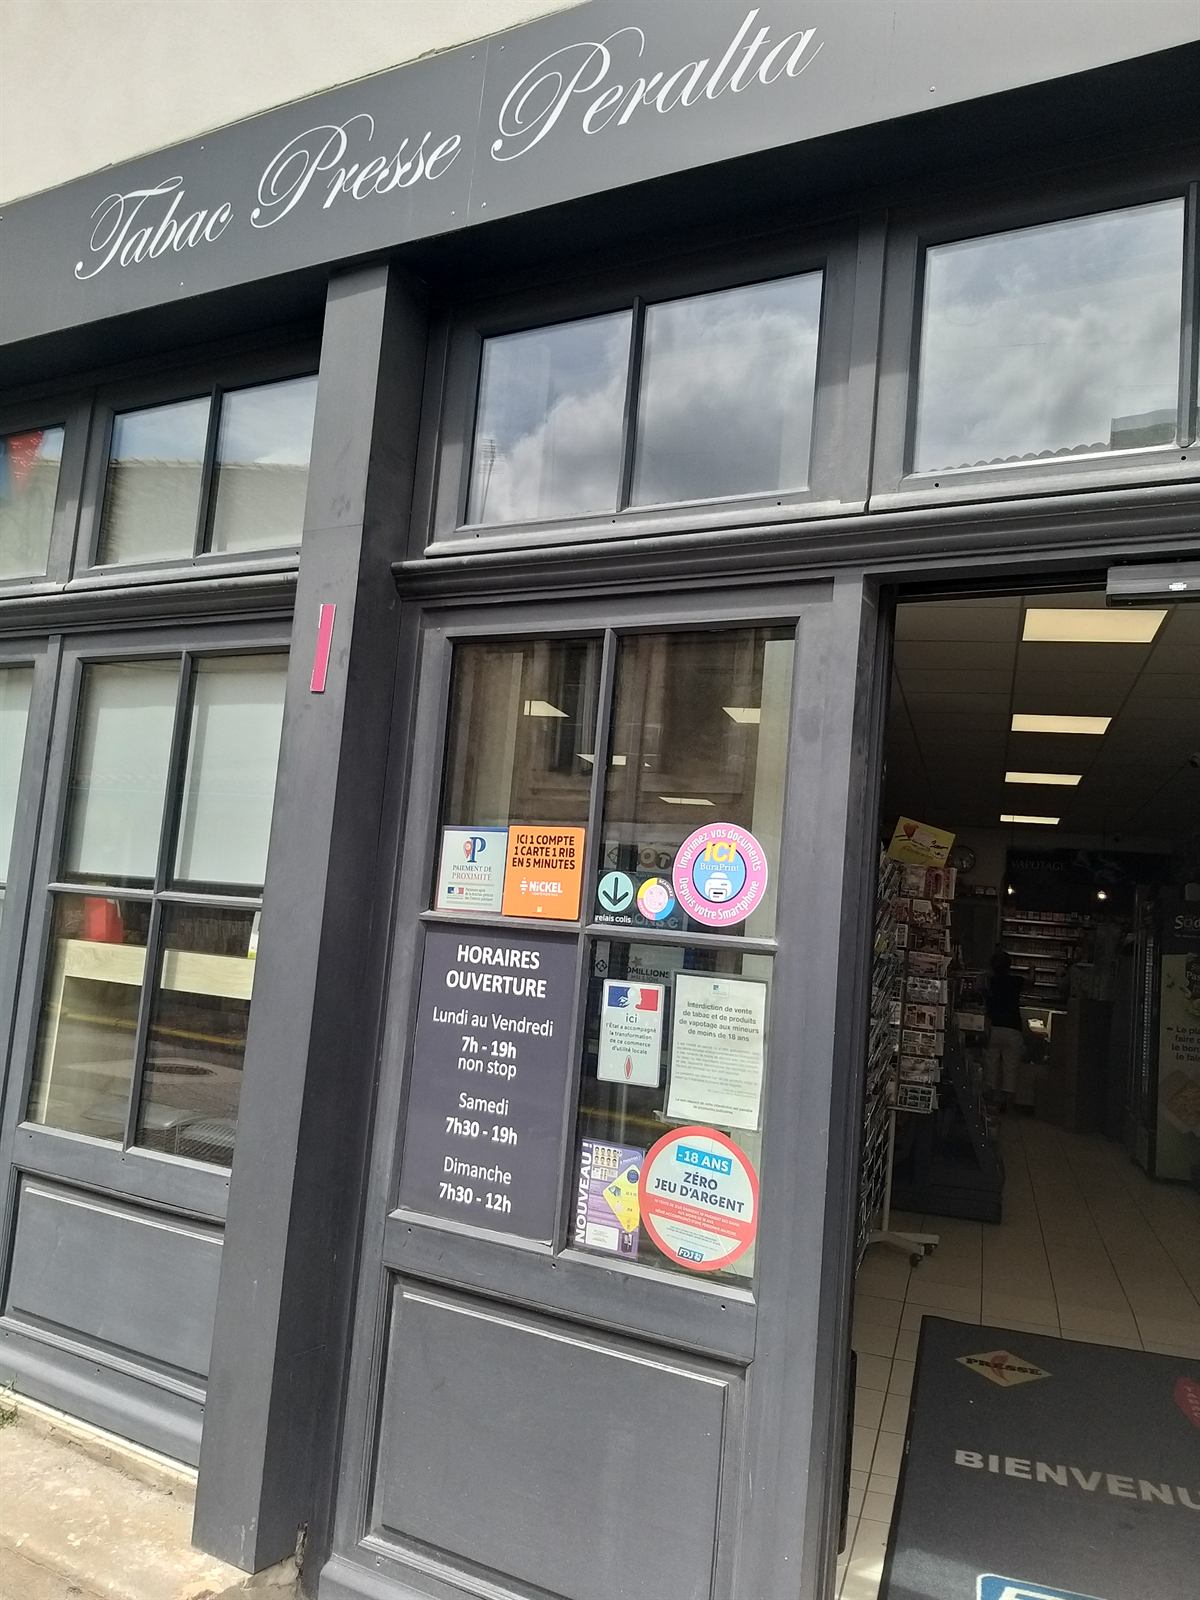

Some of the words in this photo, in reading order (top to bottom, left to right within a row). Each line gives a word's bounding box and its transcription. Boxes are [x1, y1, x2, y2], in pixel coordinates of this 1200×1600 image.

[74, 175, 234, 281] Tabac
[249, 113, 462, 228] Presse
[490, 7, 825, 162] Peralta
[516, 834, 529, 845] ICI
[530, 835, 535, 845] 1
[536, 834, 575, 846] COMPTE
[514, 846, 519, 856] 1
[520, 846, 551, 857] CARTE
[552, 847, 557, 857] 1
[559, 848, 575, 858] RIB
[677, 832, 708, 869] Imprimez
[711, 828, 727, 838] vos
[728, 828, 762, 872] documents
[703, 840, 737, 863] ICI
[452, 864, 484, 872] PAIEMENT
[512, 857, 524, 868] EN
[525, 858, 531, 868] 5
[533, 858, 576, 870] MINUTES
[679, 876, 695, 909] Depuis
[694, 901, 717, 920] votre
[717, 880, 760, 921] Smartphone
[594, 914, 614, 923] relais
[615, 915, 632, 924] colis
[457, 944, 540, 970] HORAIRES
[446, 970, 547, 998] OUVERTURE
[687, 1001, 723, 1011] Interdiction
[433, 1006, 469, 1026] Lundi
[471, 1013, 488, 1029] au
[492, 1013, 554, 1037] Vendredi
[625, 1012, 639, 1024] ici
[689, 1020, 718, 1029] vapotage
[732, 1025, 760, 1034] mineurs
[692, 1011, 710, 1019] tabac
[728, 1015, 757, 1025] produits
[614, 1031, 652, 1041] transformation
[624, 1025, 657, 1034] accompagné
[697, 1030, 717, 1038] moins
[461, 1036, 479, 1053] 7h
[491, 1040, 517, 1059] 19h
[612, 1045, 631, 1053] d'utilité
[632, 1047, 648, 1055] locale
[624, 1040, 651, 1048] commerce
[457, 1056, 484, 1073] non
[487, 1059, 517, 1081] stop
[458, 1092, 509, 1116] Samedi
[445, 1116, 480, 1138] 7h30
[491, 1125, 518, 1145] 19h
[443, 1156, 512, 1185] Dimanche
[701, 1155, 729, 1173] ANS
[683, 1171, 718, 1191] ZÉRO
[439, 1182, 474, 1204] 7h30
[485, 1192, 512, 1214] 12h
[574, 1151, 592, 1243] NOUVEAU
[654, 1178, 677, 1194] JEU
[680, 1186, 745, 1214] D'ARGENT
[679, 1248, 694, 1258] FDJ
[965, 1357, 1042, 1376] PRESSE
